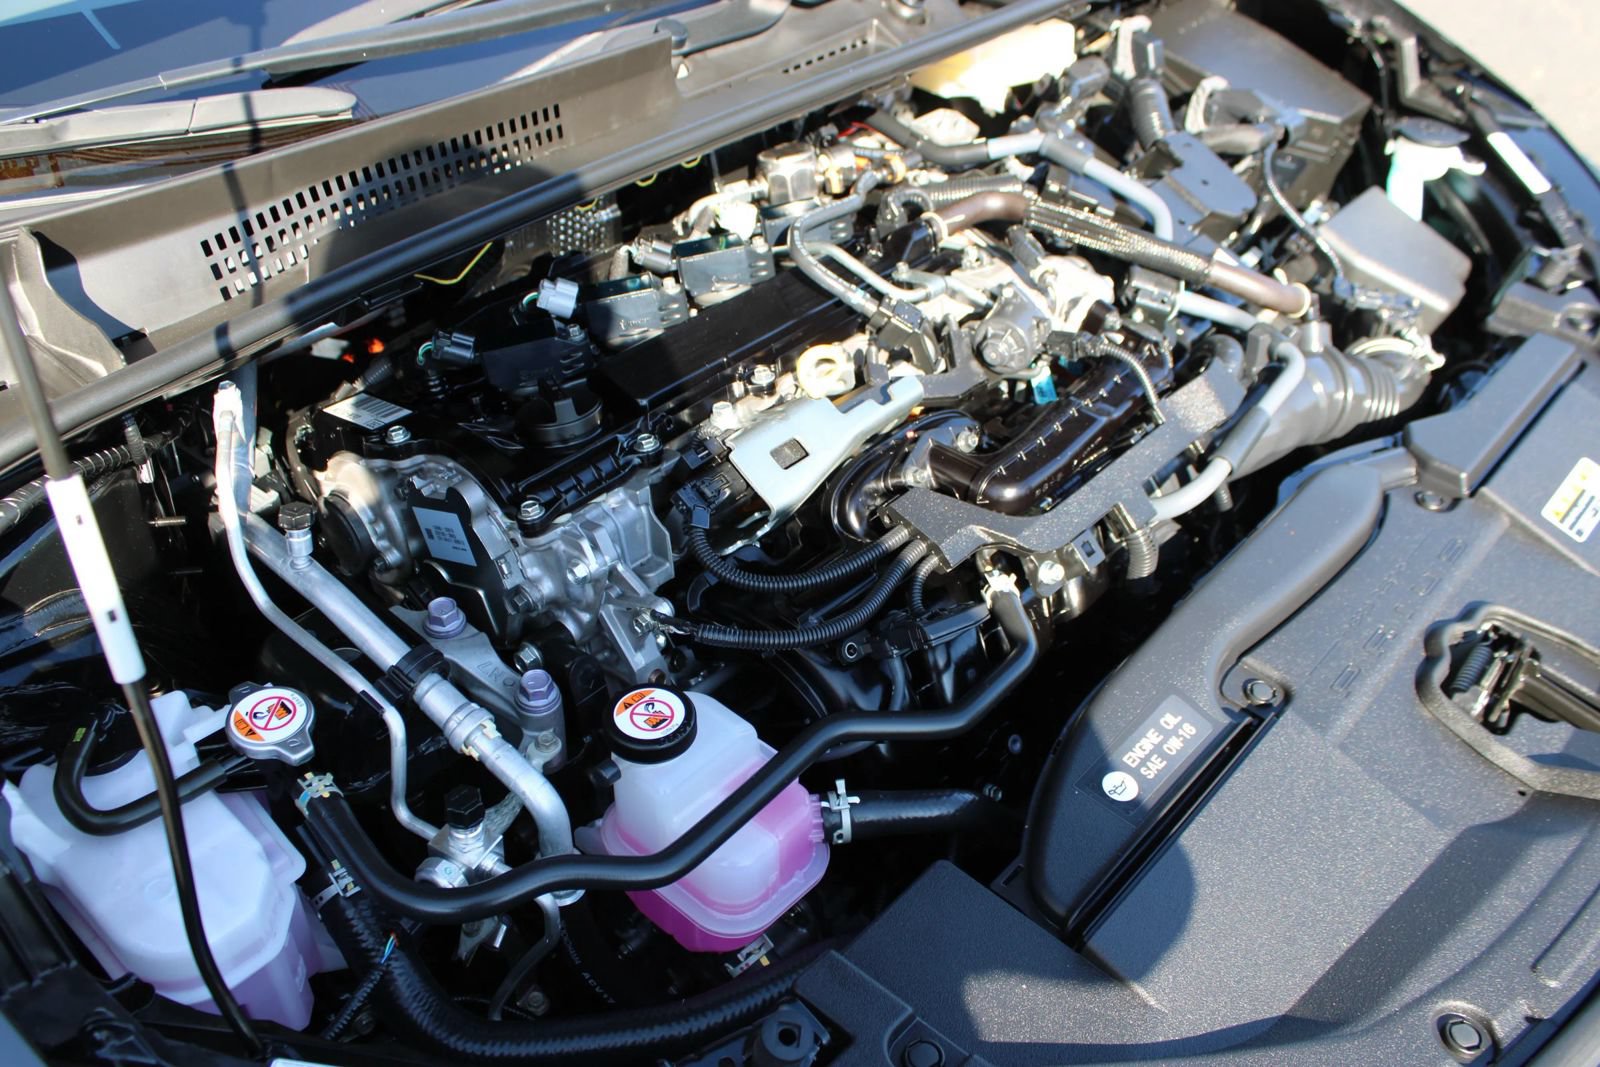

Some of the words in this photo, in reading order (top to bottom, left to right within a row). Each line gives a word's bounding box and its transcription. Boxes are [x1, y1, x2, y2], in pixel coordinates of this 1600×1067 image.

[1122, 728, 1164, 768] ENGINE
[1159, 712, 1183, 730] OIL
[1140, 754, 1167, 779] SAE
